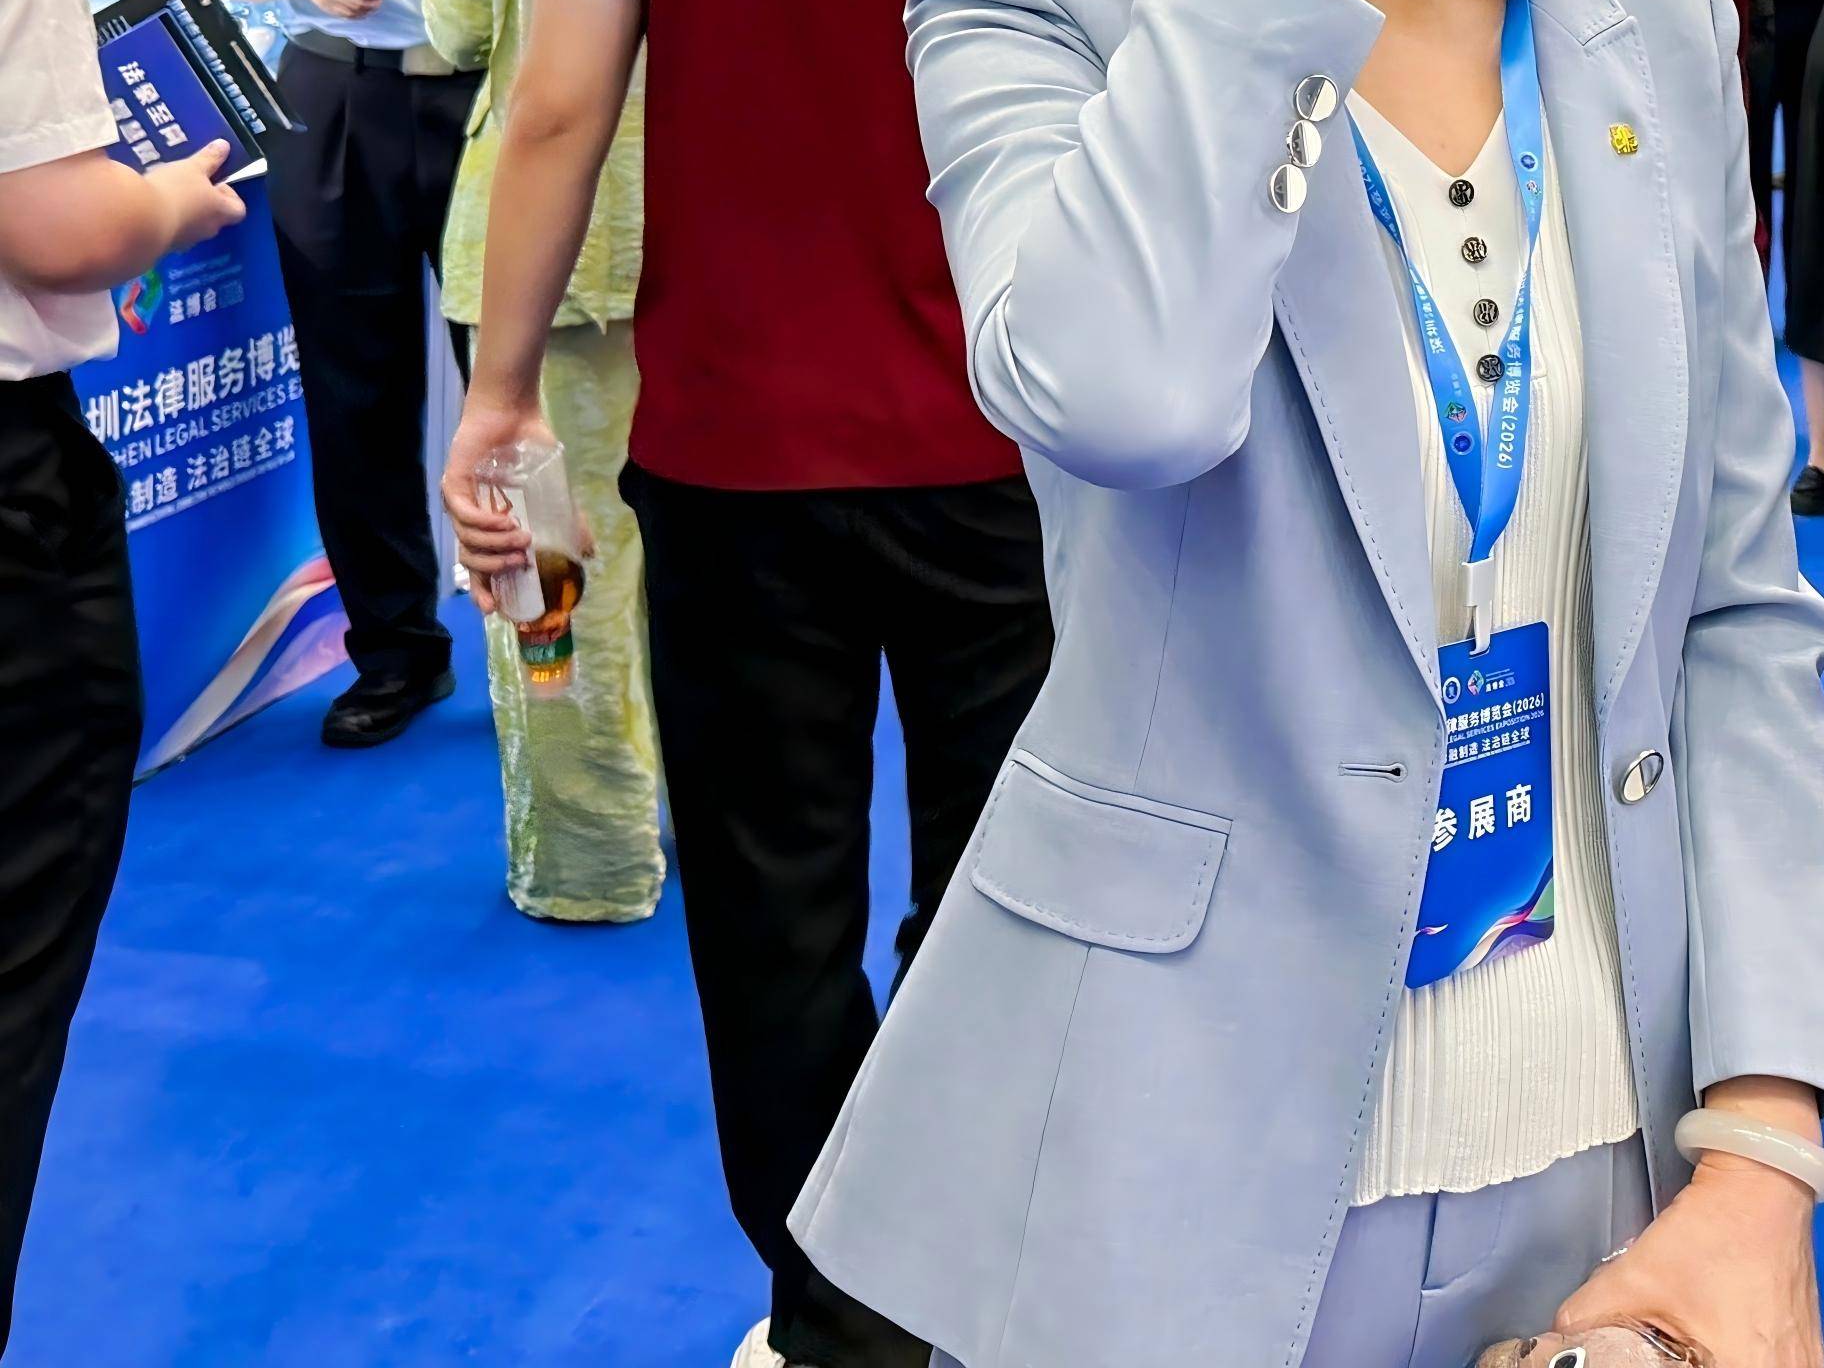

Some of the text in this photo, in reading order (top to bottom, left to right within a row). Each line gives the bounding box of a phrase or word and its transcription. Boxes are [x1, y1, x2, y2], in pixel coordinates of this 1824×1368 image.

[154, 416, 210, 456] LEGAL
[211, 383, 287, 432] SERVICES
[125, 466, 179, 519] 制造
[1432, 783, 1532, 853] 参展商
